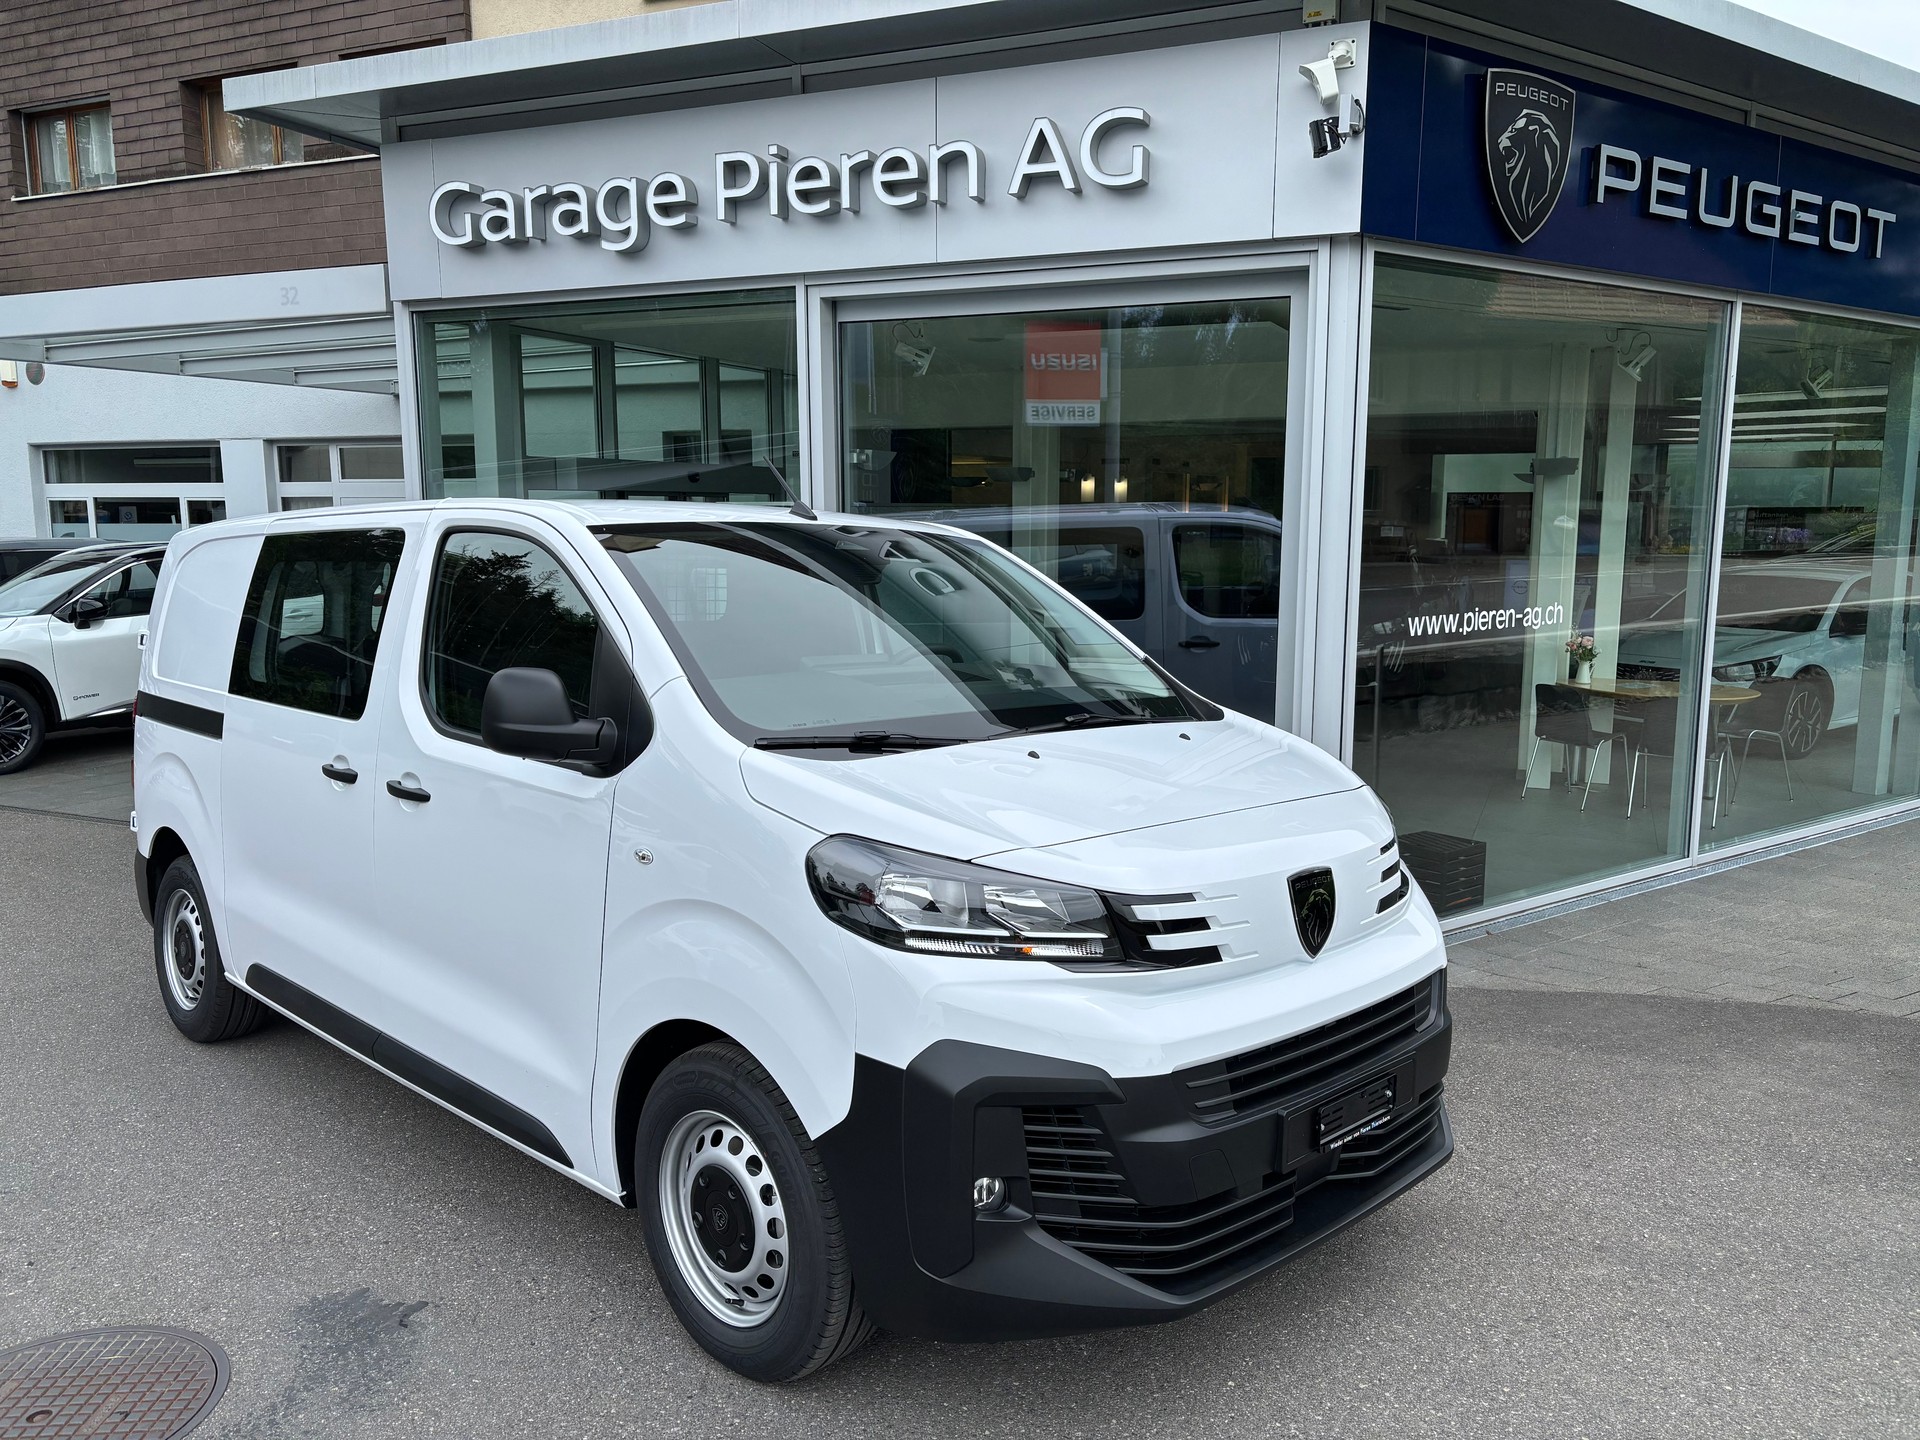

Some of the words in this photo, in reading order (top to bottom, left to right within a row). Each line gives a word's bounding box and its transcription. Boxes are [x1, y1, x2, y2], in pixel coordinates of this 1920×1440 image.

[1494, 82, 1569, 111] PEUGEOT
[428, 171, 696, 252] Garage
[715, 139, 985, 223] Pieren
[1008, 107, 1150, 199] AG
[1593, 143, 1897, 259] PEUGEOT
[280, 287, 300, 306] 32
[1408, 602, 1563, 637] www.pieren-ag.ch
[1295, 875, 1332, 891] PEUGEOT
